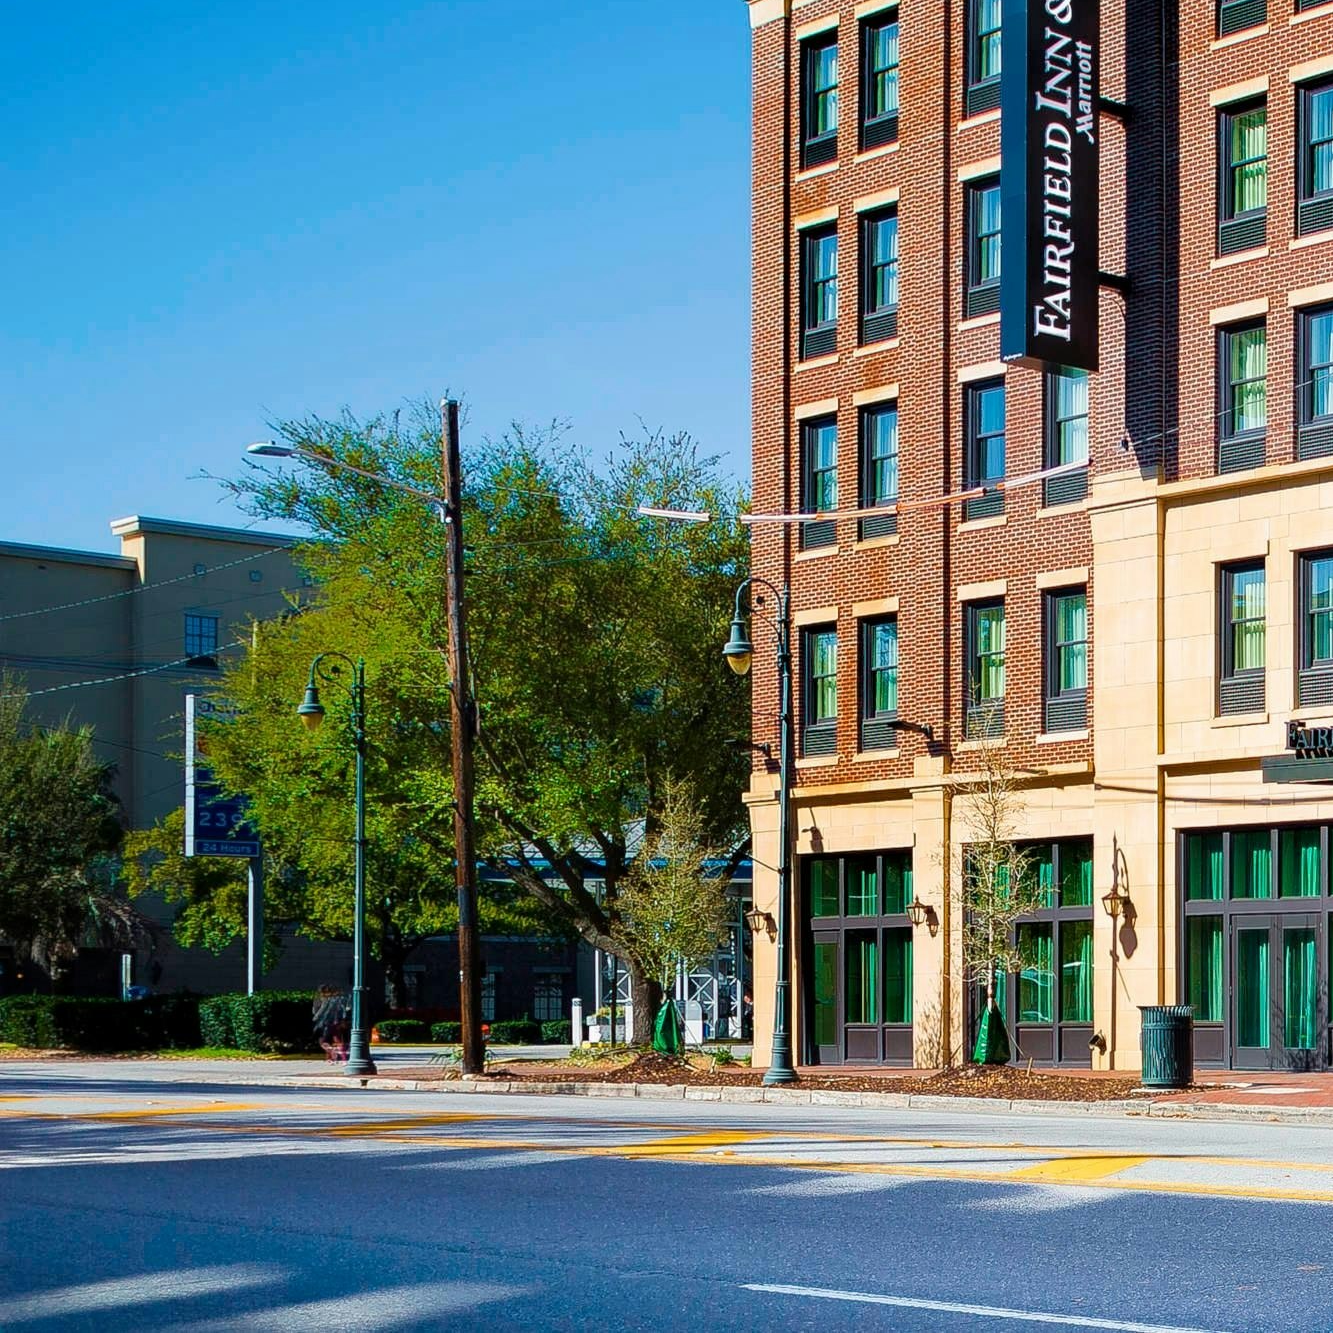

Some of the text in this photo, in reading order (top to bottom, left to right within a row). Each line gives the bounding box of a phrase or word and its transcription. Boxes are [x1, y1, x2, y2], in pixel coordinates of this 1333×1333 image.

[1035, 27, 1073, 118] INN
[1076, 41, 1095, 145] Marriott
[1034, 122, 1075, 342] FAIRFIELD
